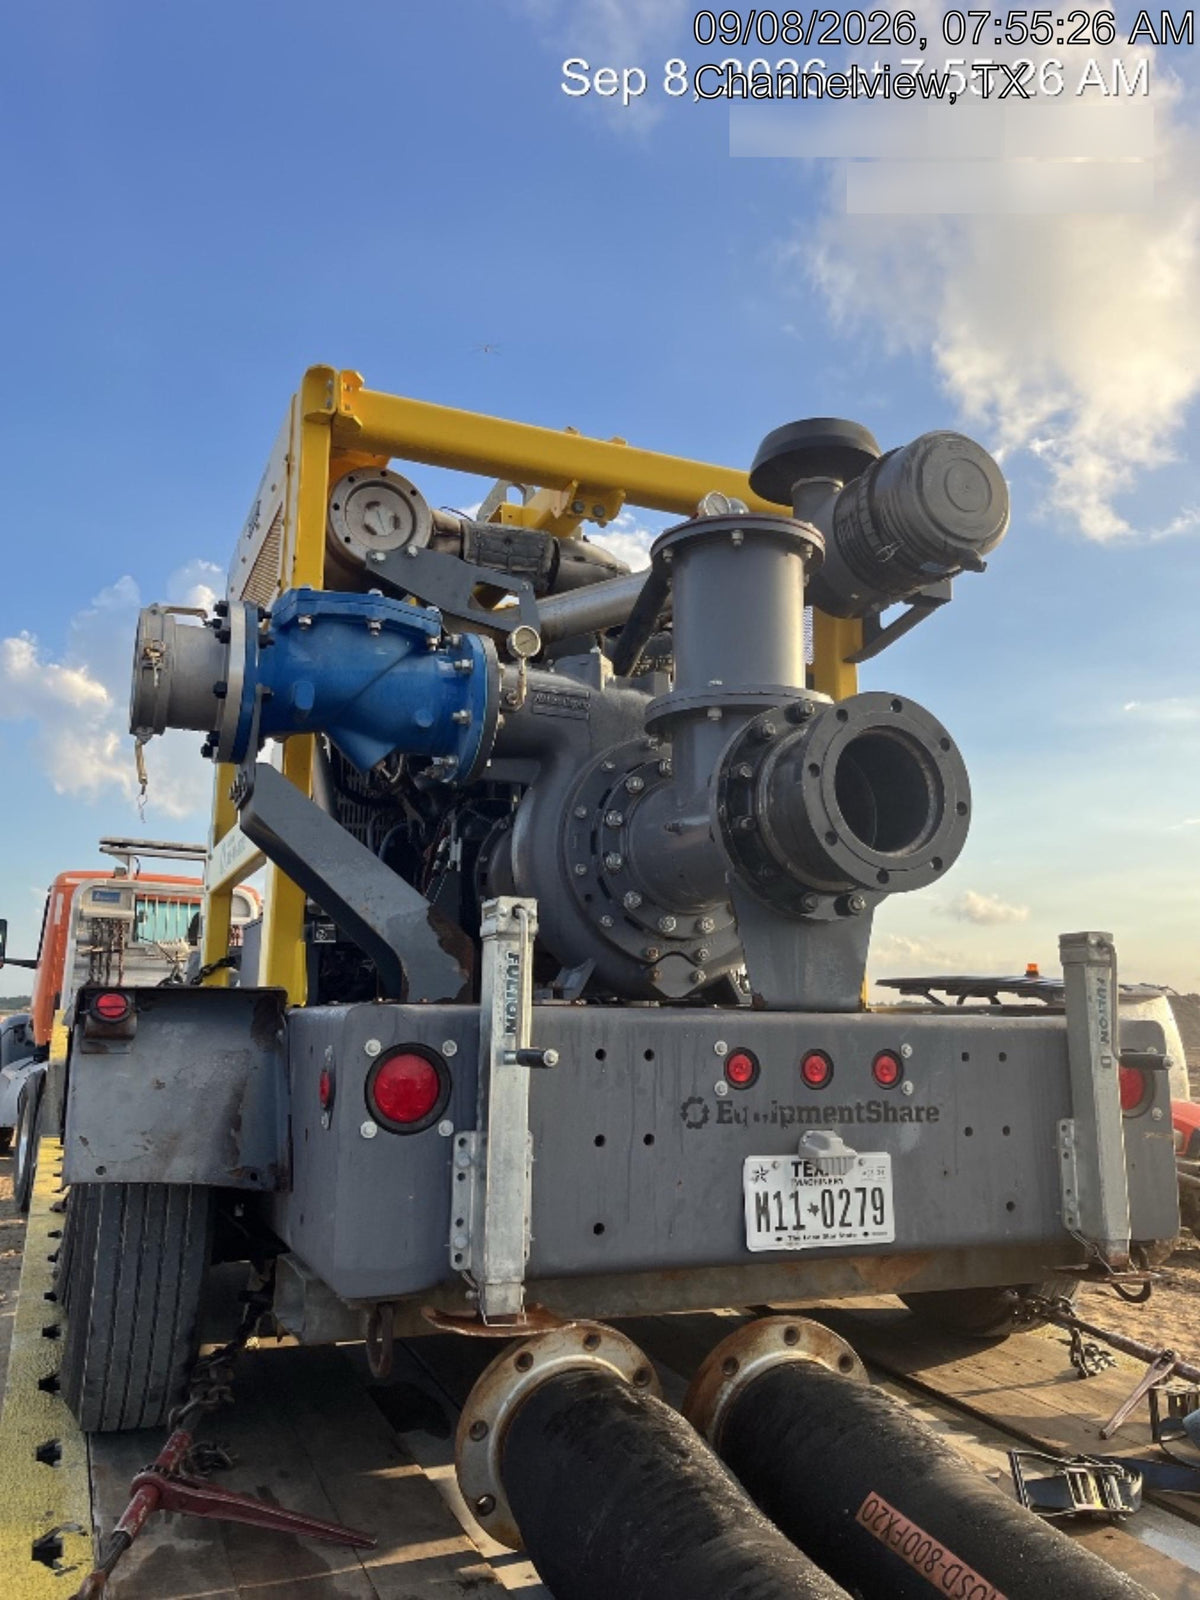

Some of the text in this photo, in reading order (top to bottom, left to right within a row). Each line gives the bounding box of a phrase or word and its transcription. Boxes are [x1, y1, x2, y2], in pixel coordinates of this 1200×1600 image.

[505, 951, 521, 1037] FULTON
[790, 1160, 846, 1178] TEX
[821, 1186, 885, 1229] 0279
[862, 1500, 997, 1600] OSD-800FX20
